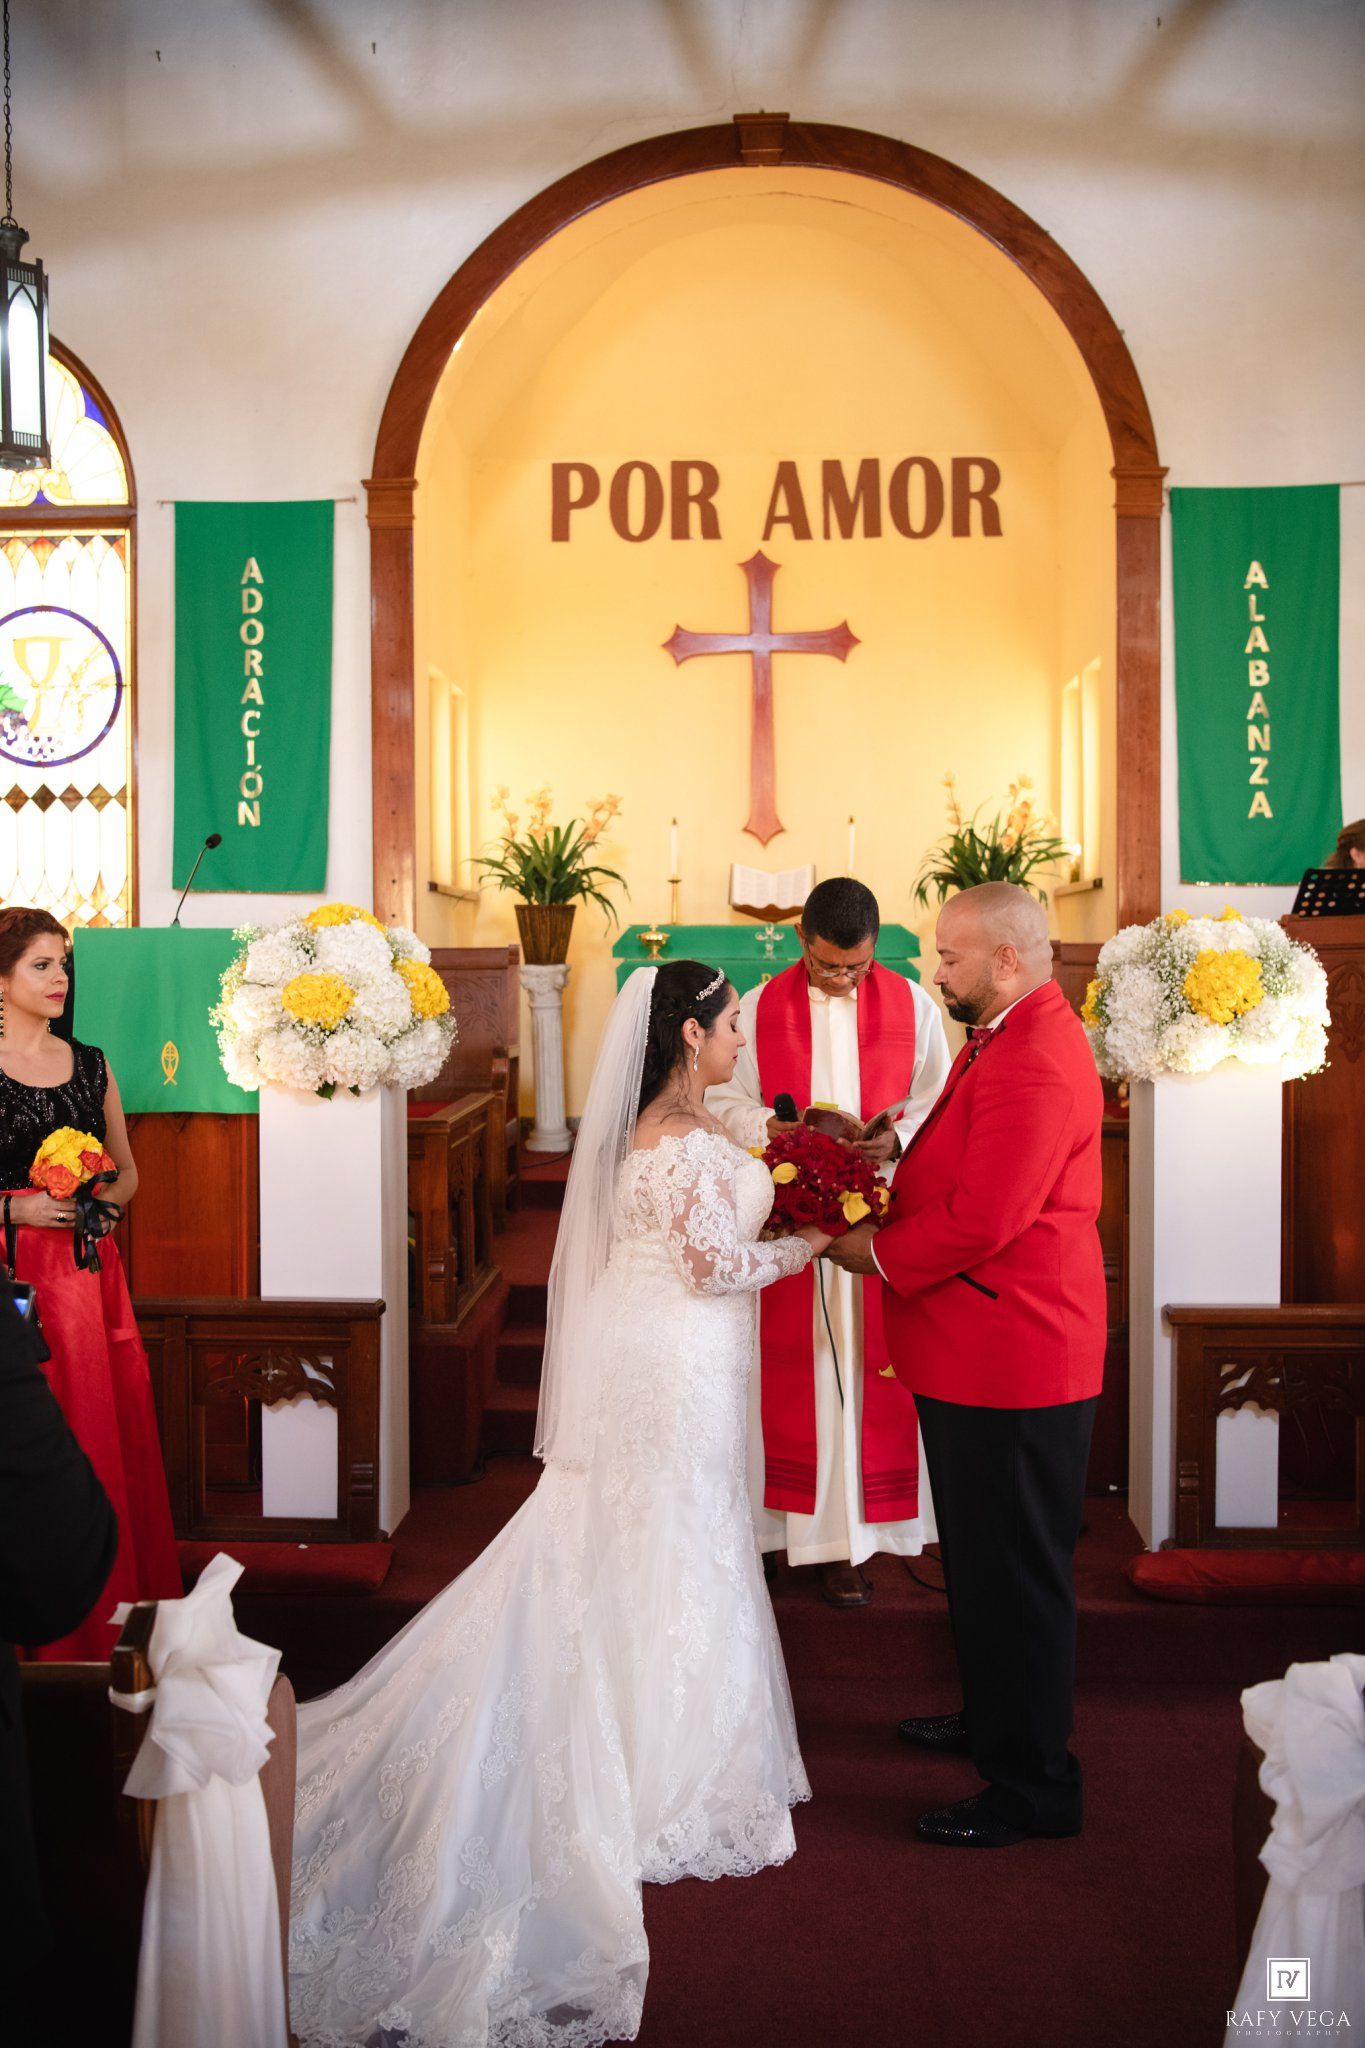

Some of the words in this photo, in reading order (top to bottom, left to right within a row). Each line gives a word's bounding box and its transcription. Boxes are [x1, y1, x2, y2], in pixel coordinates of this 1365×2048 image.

[551, 460, 722, 542] POR
[761, 456, 1003, 541] AMOR
[237, 557, 265, 827] ADORACIÓN
[1243, 560, 1274, 819] ALABANZA
